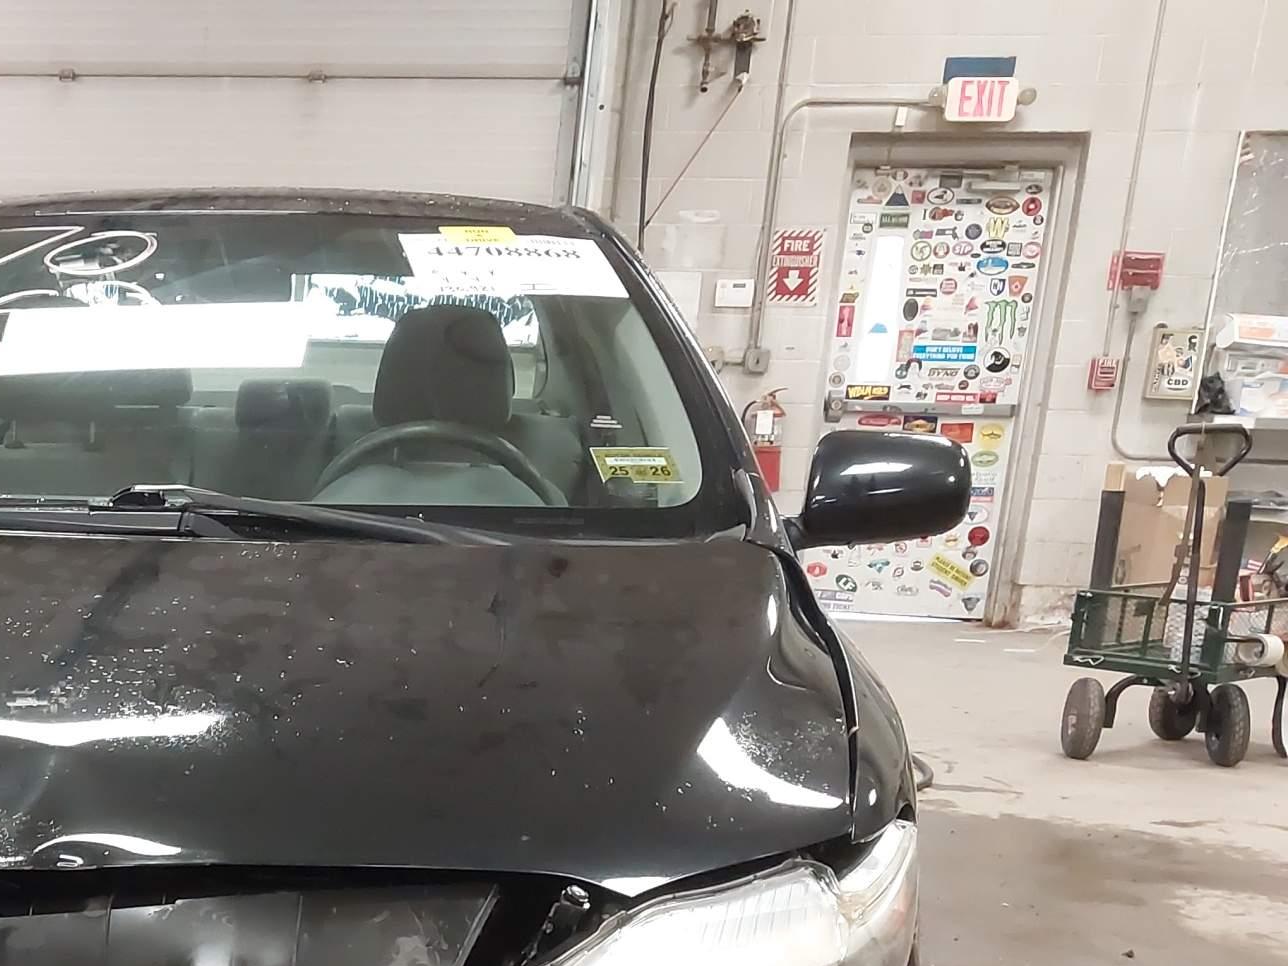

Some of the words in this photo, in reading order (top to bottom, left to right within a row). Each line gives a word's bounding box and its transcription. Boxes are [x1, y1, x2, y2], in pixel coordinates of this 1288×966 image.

[958, 81, 1010, 117] EXIT
[783, 240, 810, 251] FIRE
[427, 246, 581, 259] 44708868
[1167, 378, 1189, 386] CBD
[609, 466, 630, 476] 25
[649, 466, 672, 476] 26
